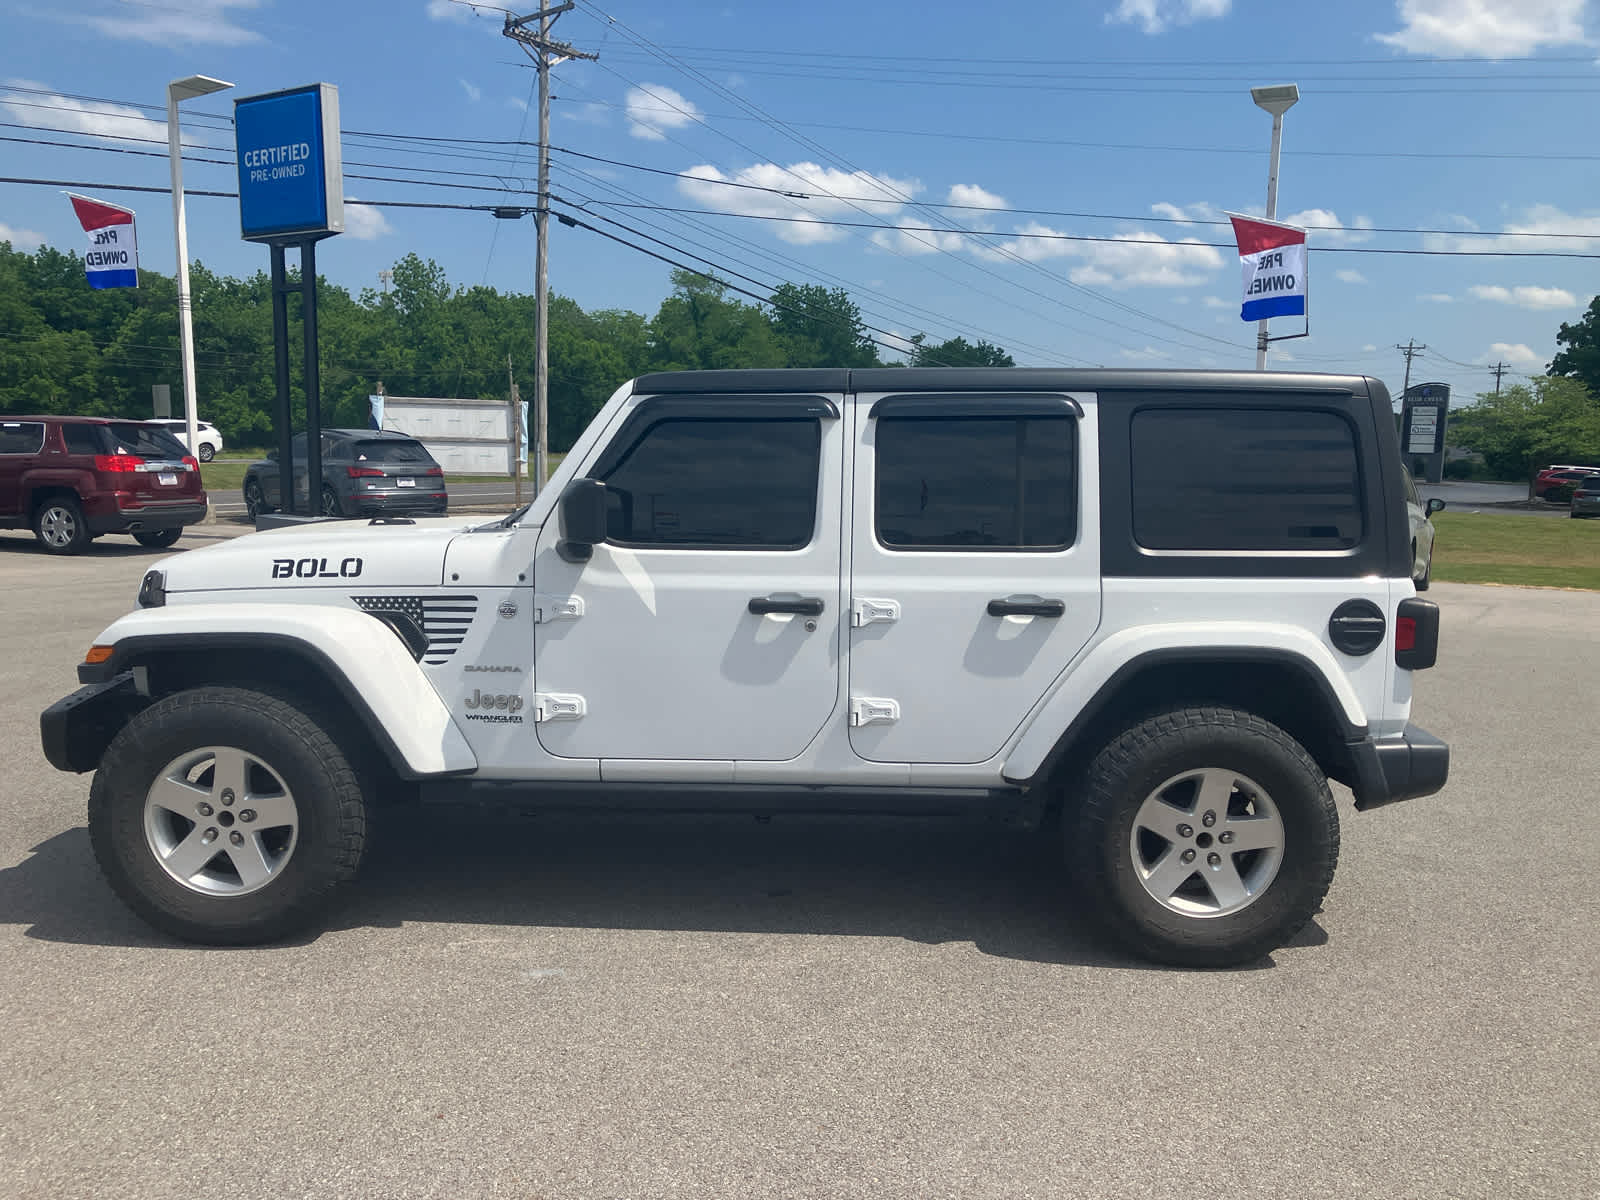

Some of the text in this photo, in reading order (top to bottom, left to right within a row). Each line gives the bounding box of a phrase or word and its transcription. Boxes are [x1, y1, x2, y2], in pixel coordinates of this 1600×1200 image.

[244, 143, 310, 167] CERTIFIED
[250, 164, 305, 182] PRE-OWNED
[271, 558, 363, 578] BOLO
[464, 688, 523, 714] Jeep
